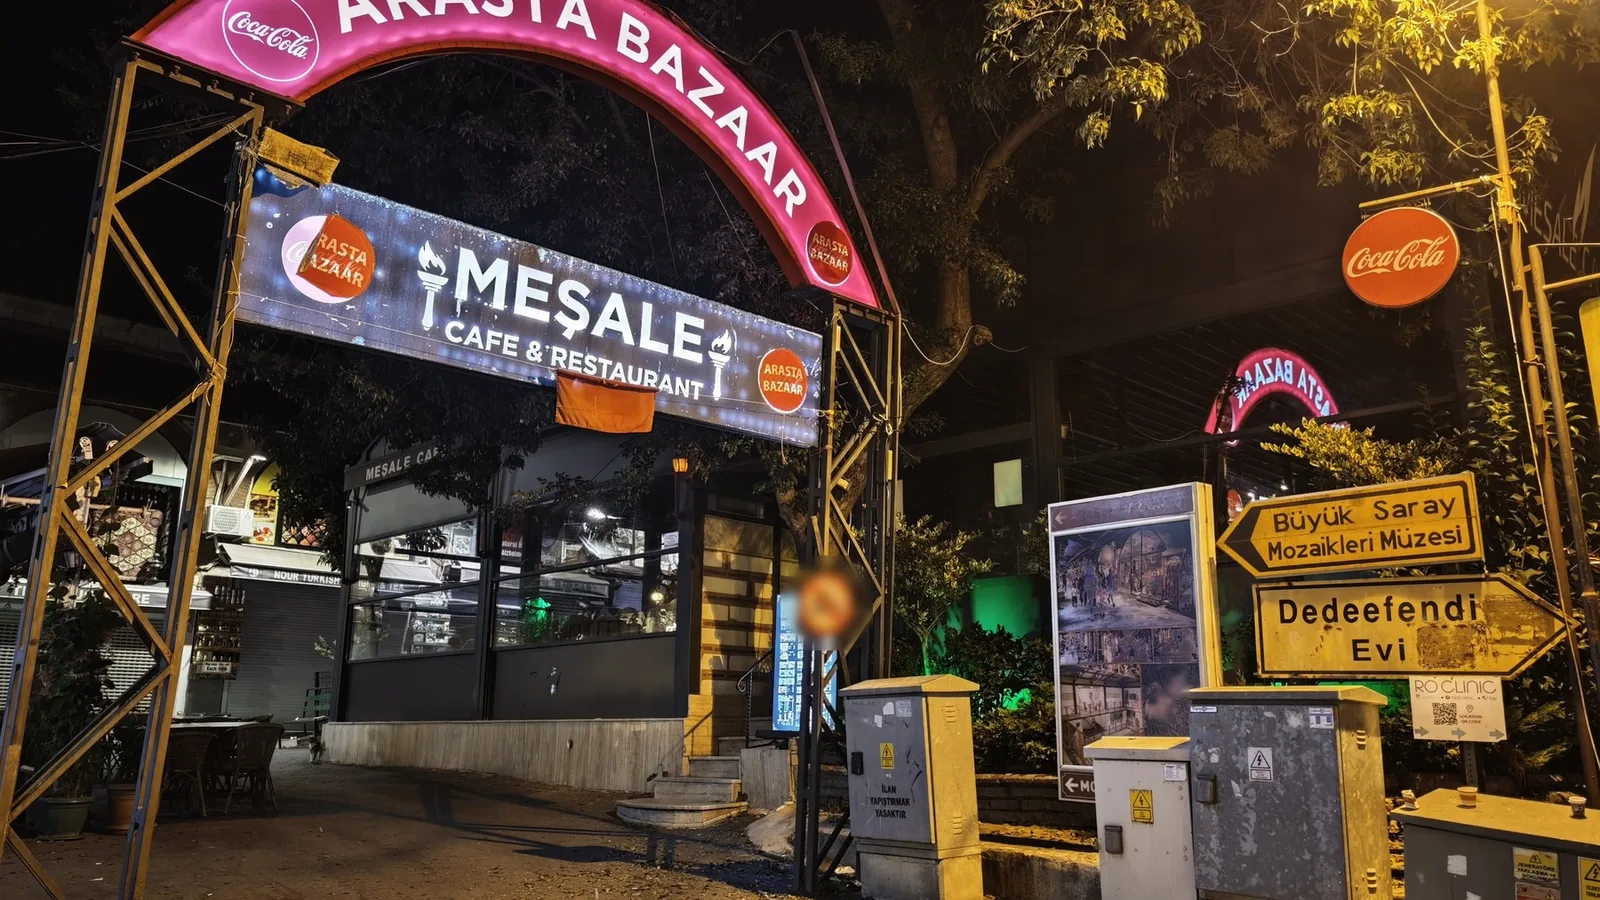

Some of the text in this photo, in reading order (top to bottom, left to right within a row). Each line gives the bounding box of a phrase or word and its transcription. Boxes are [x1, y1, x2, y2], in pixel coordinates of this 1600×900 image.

[228, 11, 314, 60] Coca-Cola
[616, 12, 807, 218] BAZAAR
[316, 232, 367, 267] RASTA
[812, 232, 848, 256] ARASTA
[1347, 235, 1450, 278] Coca-Cola
[310, 253, 364, 288] AZAAR
[810, 247, 848, 272] BAZAAR
[454, 246, 706, 364] MEŞALE
[445, 321, 704, 401] CAFE & RESTAURANT
[764, 363, 803, 380] ARASTA
[763, 379, 803, 397] BAZAAR
[366, 455, 412, 482] MEŞALE
[1273, 497, 1456, 534] Büyük Saray
[1268, 525, 1463, 561] Mozaikleri Müzesi
[274, 570, 299, 581] NOUR
[1278, 593, 1478, 625] Dedeefendi
[1351, 638, 1406, 662] Evi
[1414, 680, 1497, 694] RO CLINIC
[870, 797, 911, 807] YAPIŞTIRMAK
[881, 784, 897, 794] İLAN
[875, 809, 907, 819] YASAKTIR
